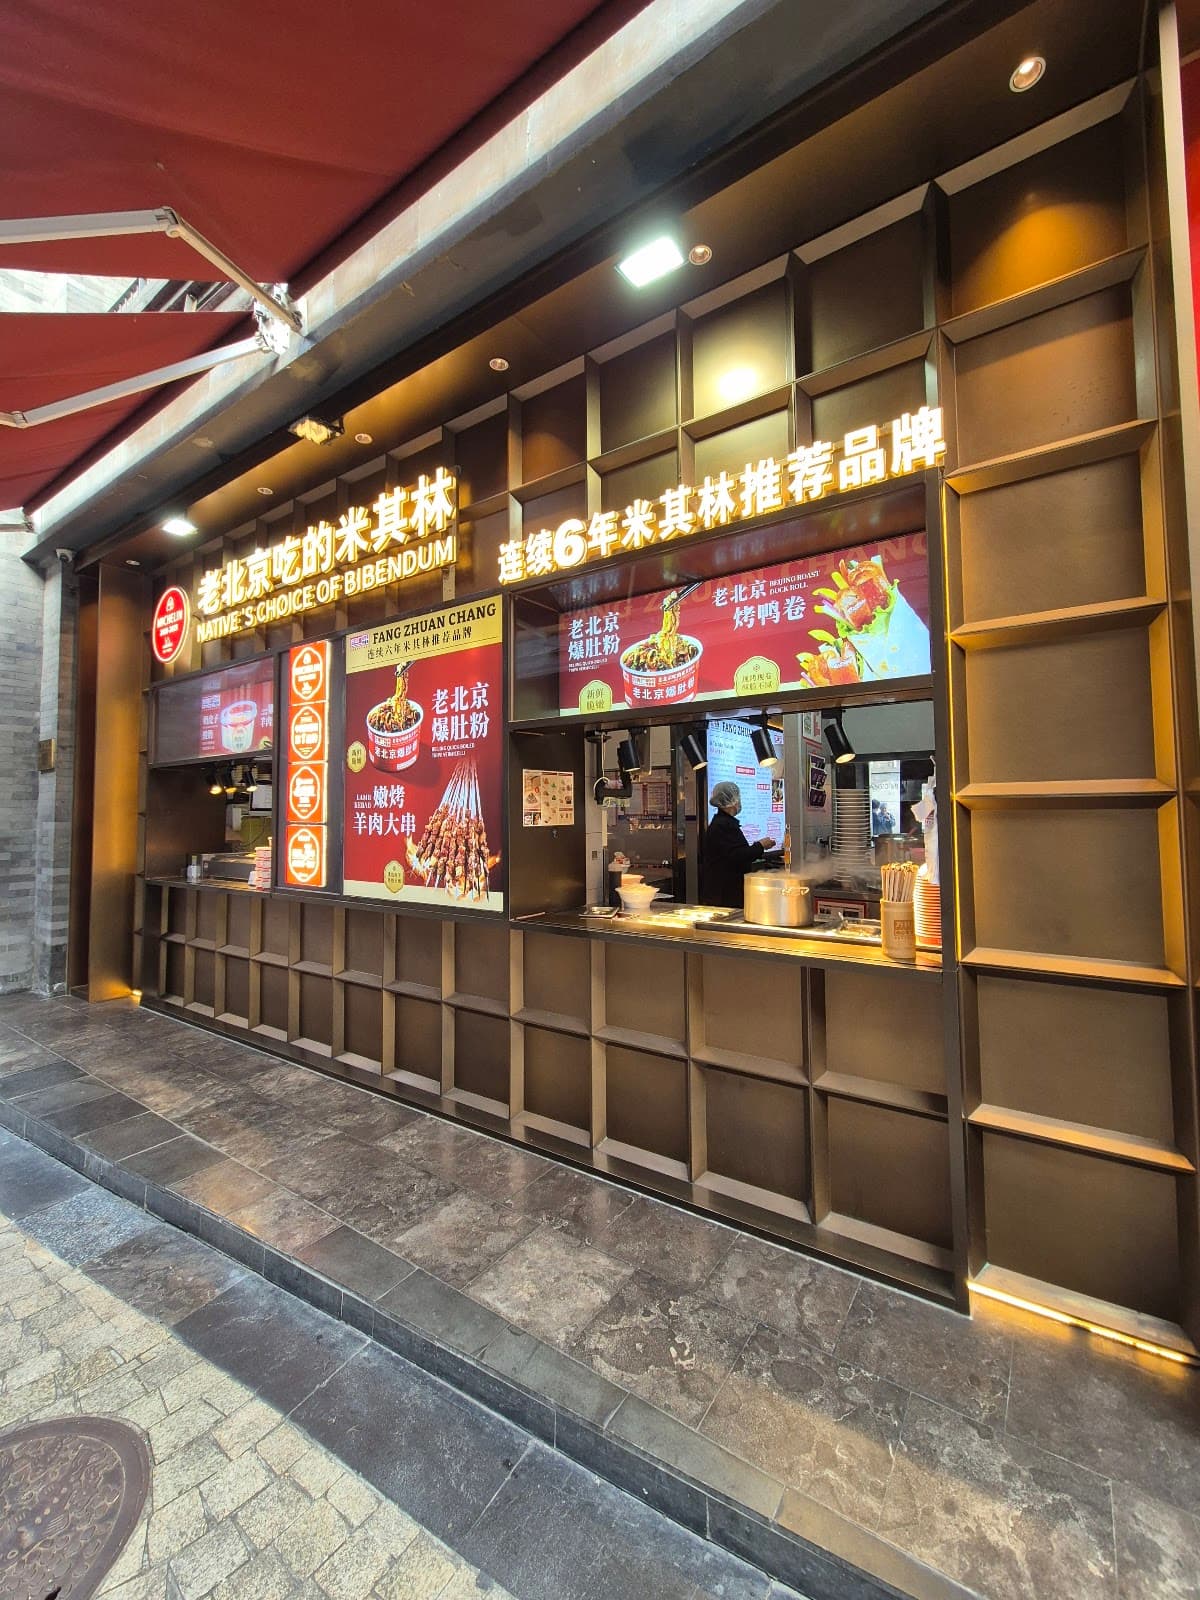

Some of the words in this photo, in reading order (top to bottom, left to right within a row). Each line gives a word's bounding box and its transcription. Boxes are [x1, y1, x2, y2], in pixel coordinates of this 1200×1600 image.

[498, 405, 946, 585] 连续6年米其林推荐品牌
[197, 466, 456, 615] 老北京吃的米其林
[255, 584, 317, 624] CHOICE
[316, 577, 344, 604] OF
[344, 535, 457, 598] BIBENDUM
[711, 579, 767, 607] 老北京
[769, 575, 796, 587] BEIJING
[796, 570, 820, 581] ROAST
[769, 585, 789, 596] DUCK
[789, 581, 808, 592] ROLL
[373, 627, 401, 645] FANG
[403, 615, 446, 637] ZHUAN
[448, 603, 497, 626] CHANG
[568, 611, 620, 640] 老北京
[733, 595, 807, 632] 烤鸭卷
[367, 626, 472, 660] 连续六年米其林推荐品牌
[568, 633, 621, 661] 爆肚粉
[432, 681, 490, 715] 老北京
[431, 711, 490, 743] 爆肚粉
[373, 784, 406, 809] 嫩烤
[352, 811, 416, 837] 羊肉大串
